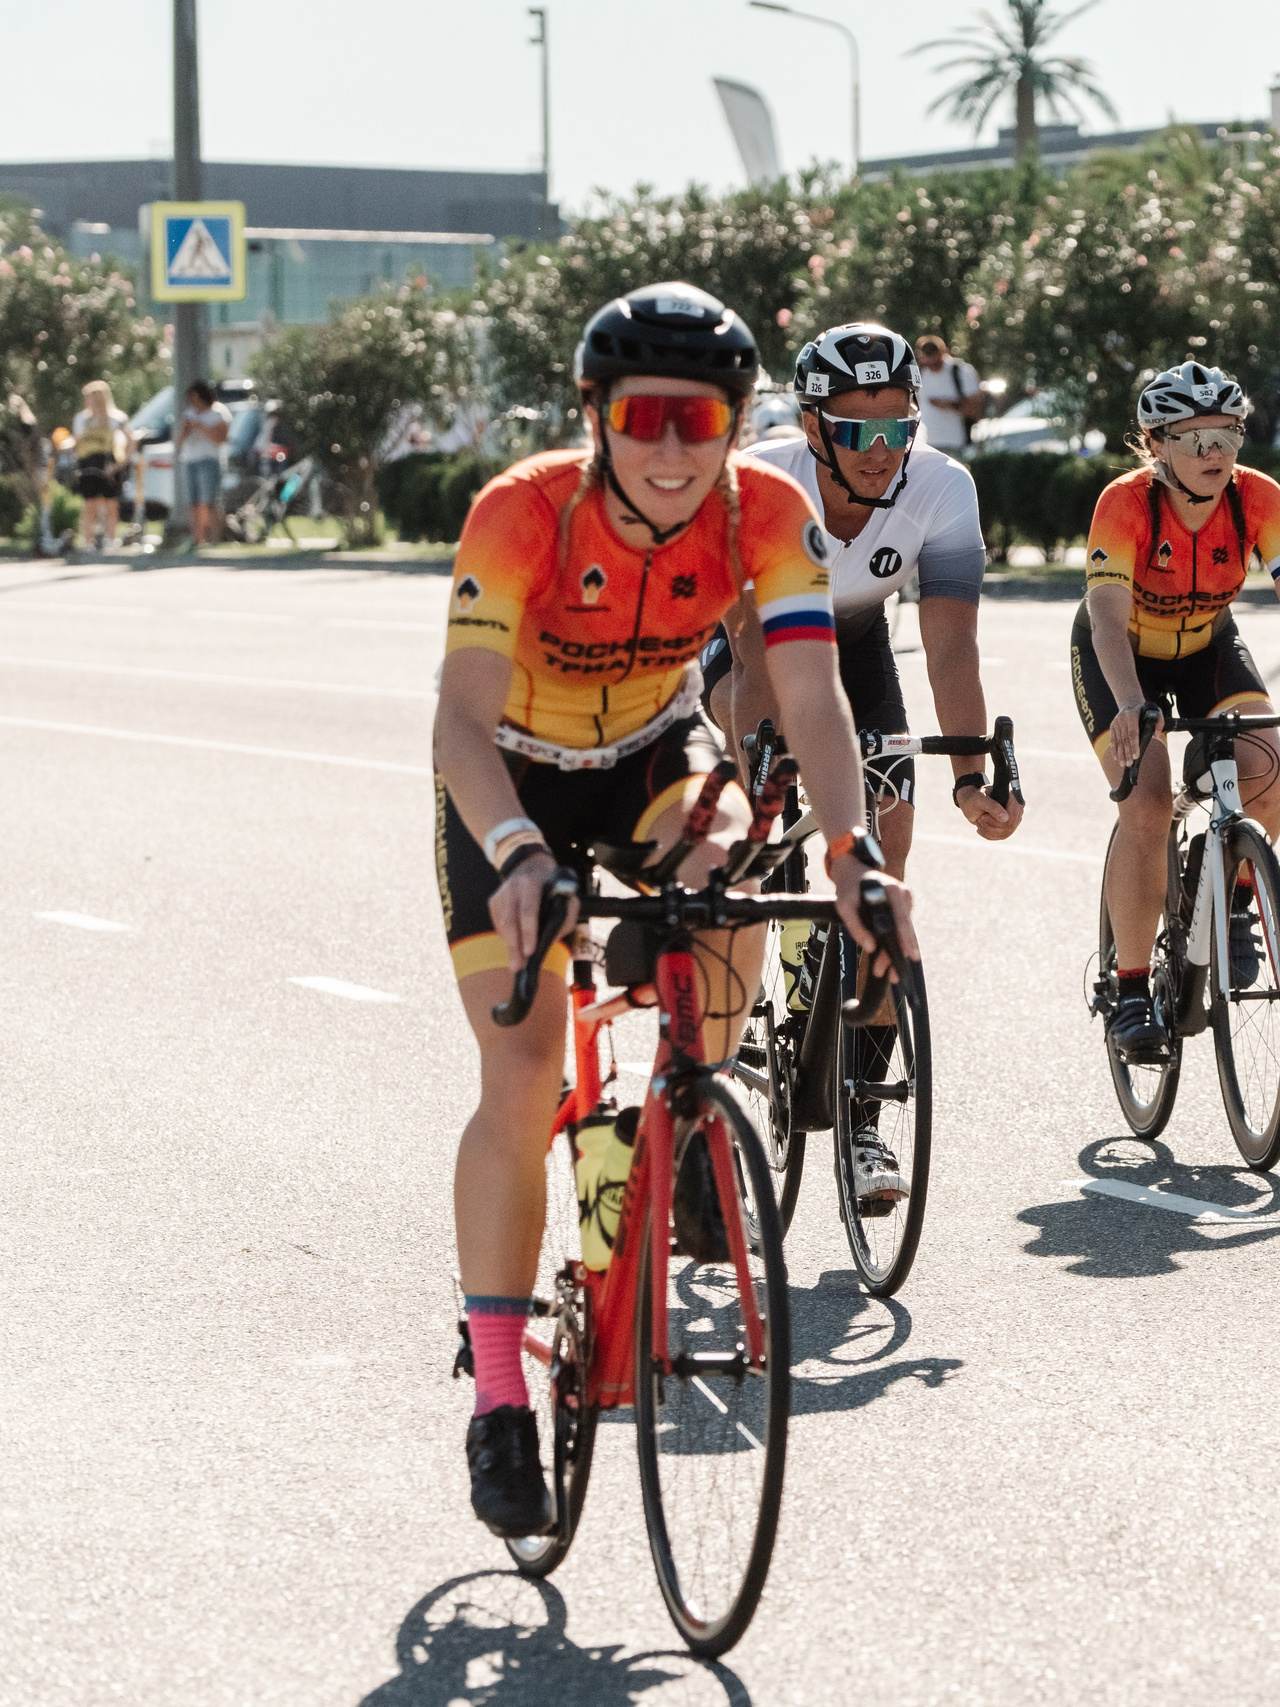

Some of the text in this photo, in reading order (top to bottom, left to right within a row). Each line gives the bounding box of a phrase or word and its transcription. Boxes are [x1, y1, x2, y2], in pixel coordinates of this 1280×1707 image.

[810, 382, 823, 393] 326
[864, 370, 882, 381] 326
[1199, 389, 1214, 397] 582
[1133, 580, 1241, 606] РОСНЕФТ
[540, 628, 709, 658] РОСНЕФТ
[1071, 645, 1096, 734] РОСНЕФТЬ
[760, 744, 772, 785] SRAM
[1003, 739, 1018, 778] SRAM
